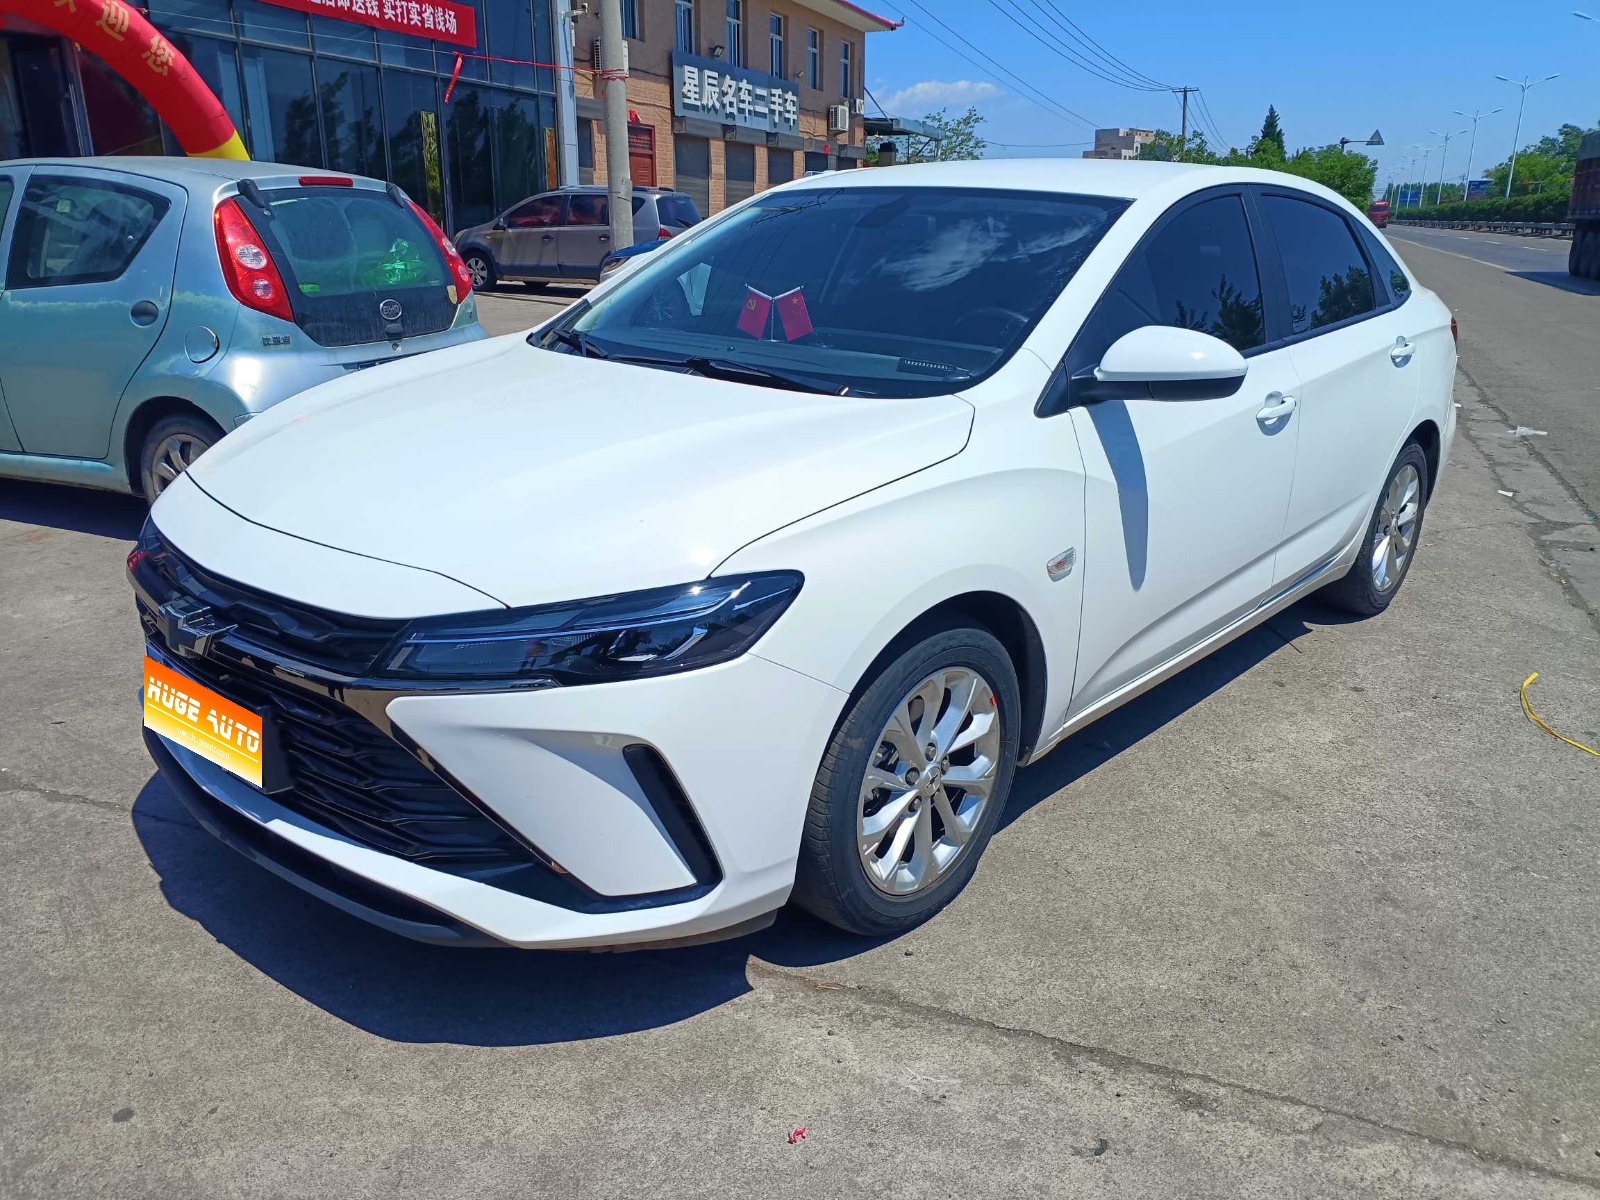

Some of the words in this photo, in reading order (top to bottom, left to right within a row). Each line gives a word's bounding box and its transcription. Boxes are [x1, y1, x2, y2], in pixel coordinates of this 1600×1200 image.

[682, 65, 797, 126] 星辰名车二手车
